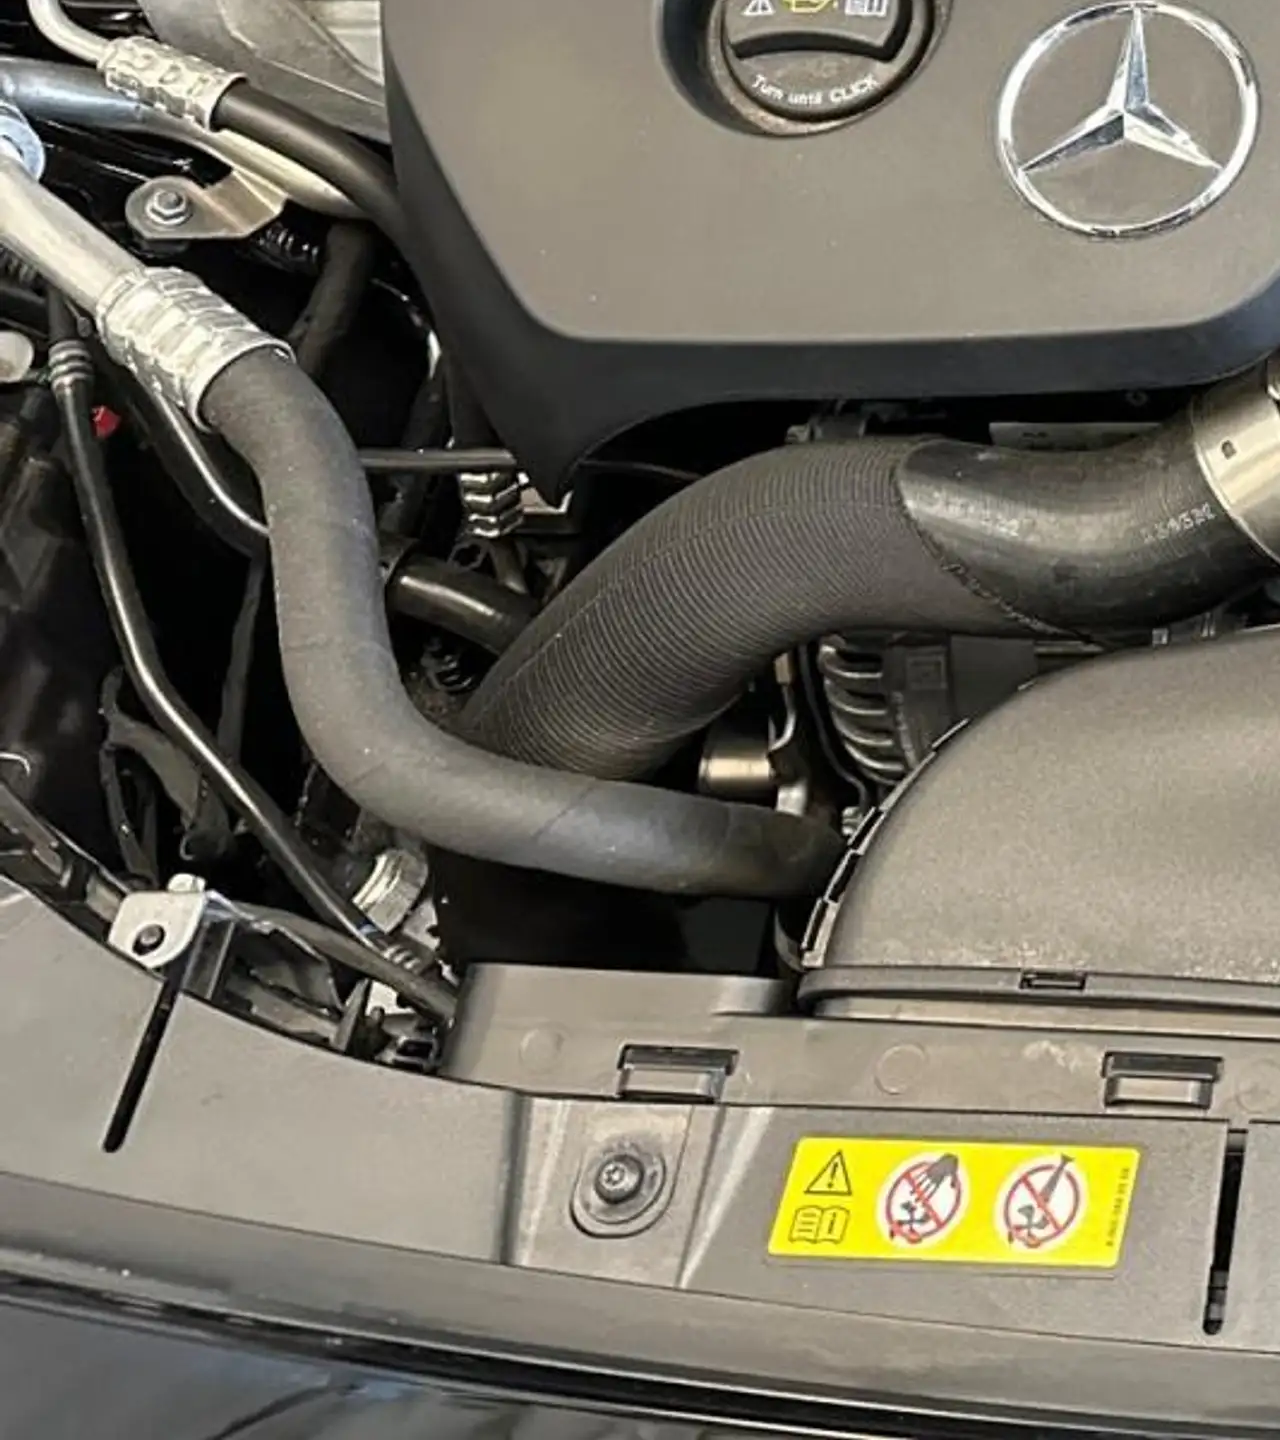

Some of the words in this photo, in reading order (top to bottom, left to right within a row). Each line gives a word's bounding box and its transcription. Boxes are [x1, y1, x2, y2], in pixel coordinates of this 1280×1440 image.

[751, 73, 784, 101] Turn
[788, 89, 823, 107] until
[828, 73, 880, 103] CLICK
